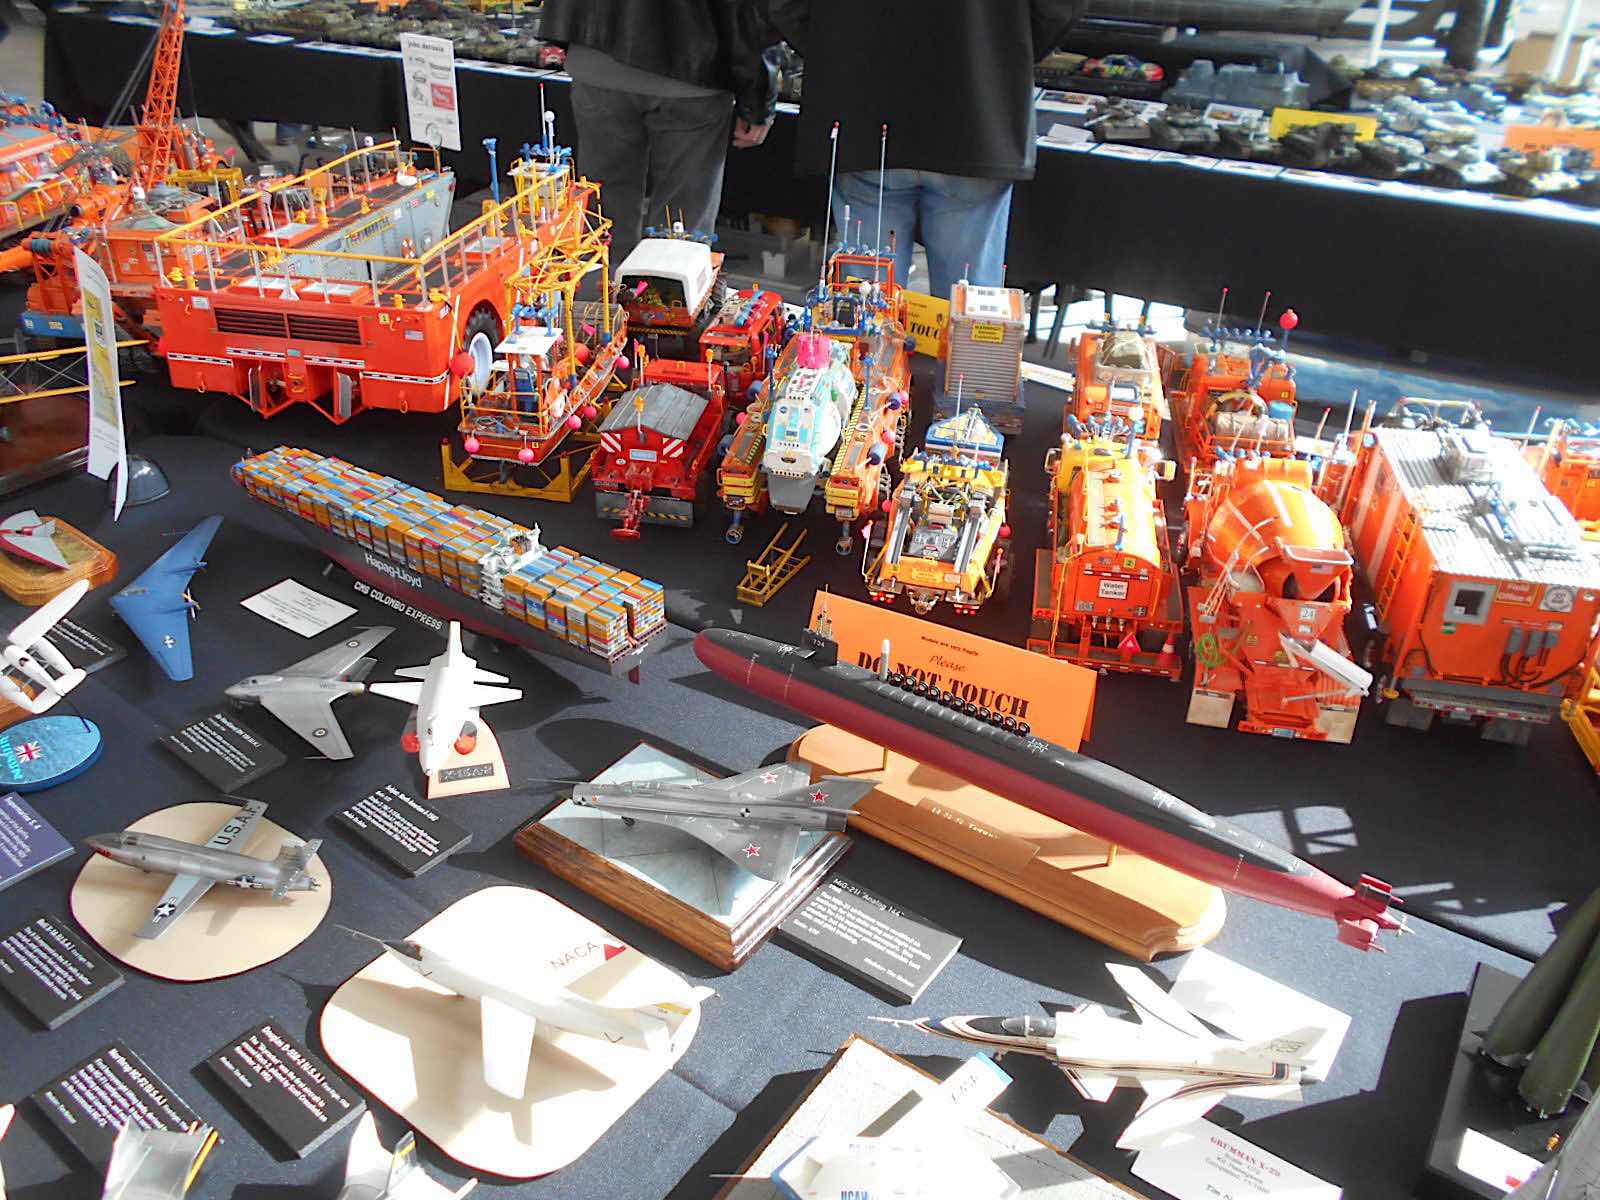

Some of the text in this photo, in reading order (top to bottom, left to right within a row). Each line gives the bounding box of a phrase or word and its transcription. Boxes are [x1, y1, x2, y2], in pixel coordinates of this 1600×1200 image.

[911, 321, 940, 340] TOUC
[1101, 589, 1125, 597] Tanker
[370, 589, 406, 612] COLOMBO
[405, 606, 442, 630] EXPRESS
[896, 662, 942, 688] NOT
[950, 677, 1030, 719] TOUCH
[550, 941, 600, 970] NACA
[1210, 1135, 1258, 1165] GRUMMAN
